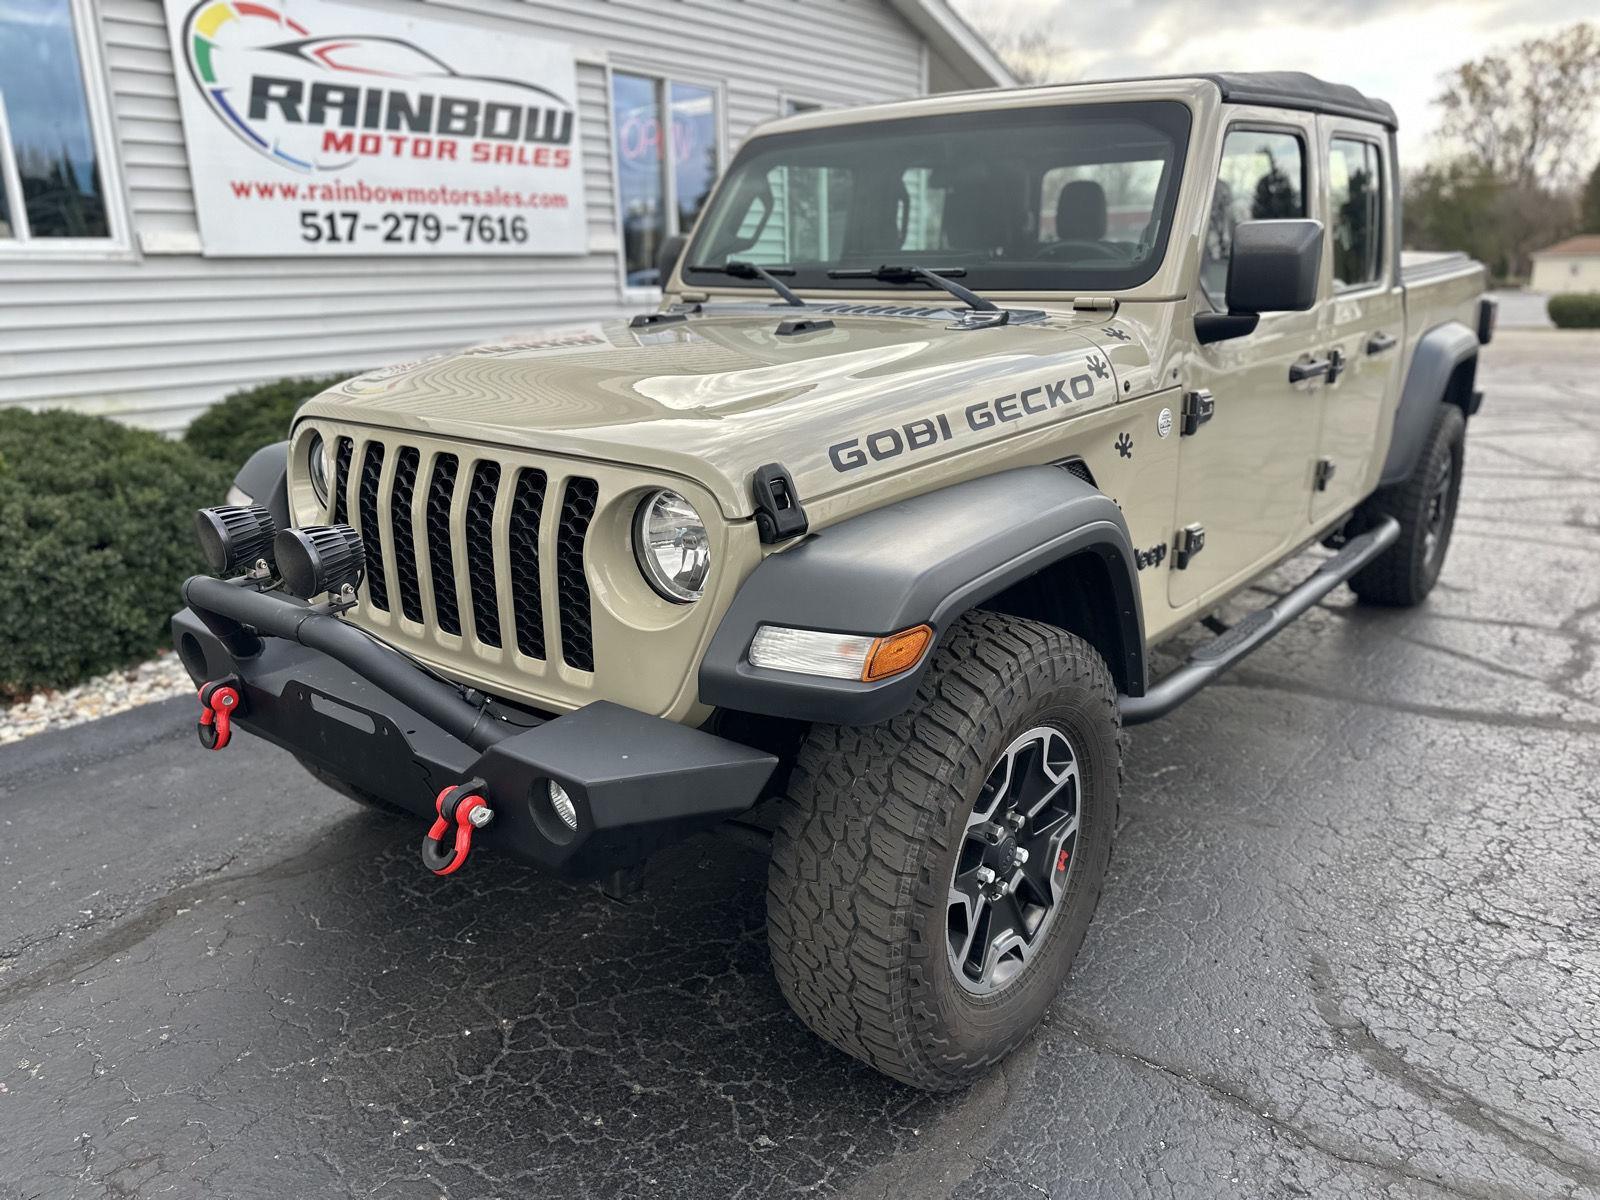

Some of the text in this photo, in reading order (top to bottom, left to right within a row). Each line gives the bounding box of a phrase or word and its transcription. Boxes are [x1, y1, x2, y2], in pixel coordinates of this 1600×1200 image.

[248, 75, 574, 146] RAINBOW
[322, 130, 570, 168] MOTOR SALES
[230, 180, 568, 208] www.rainbowmotorsales.com
[300, 210, 529, 243] 517-279-7616
[828, 413, 953, 473] GOBI
[965, 374, 1095, 432] GECKO
